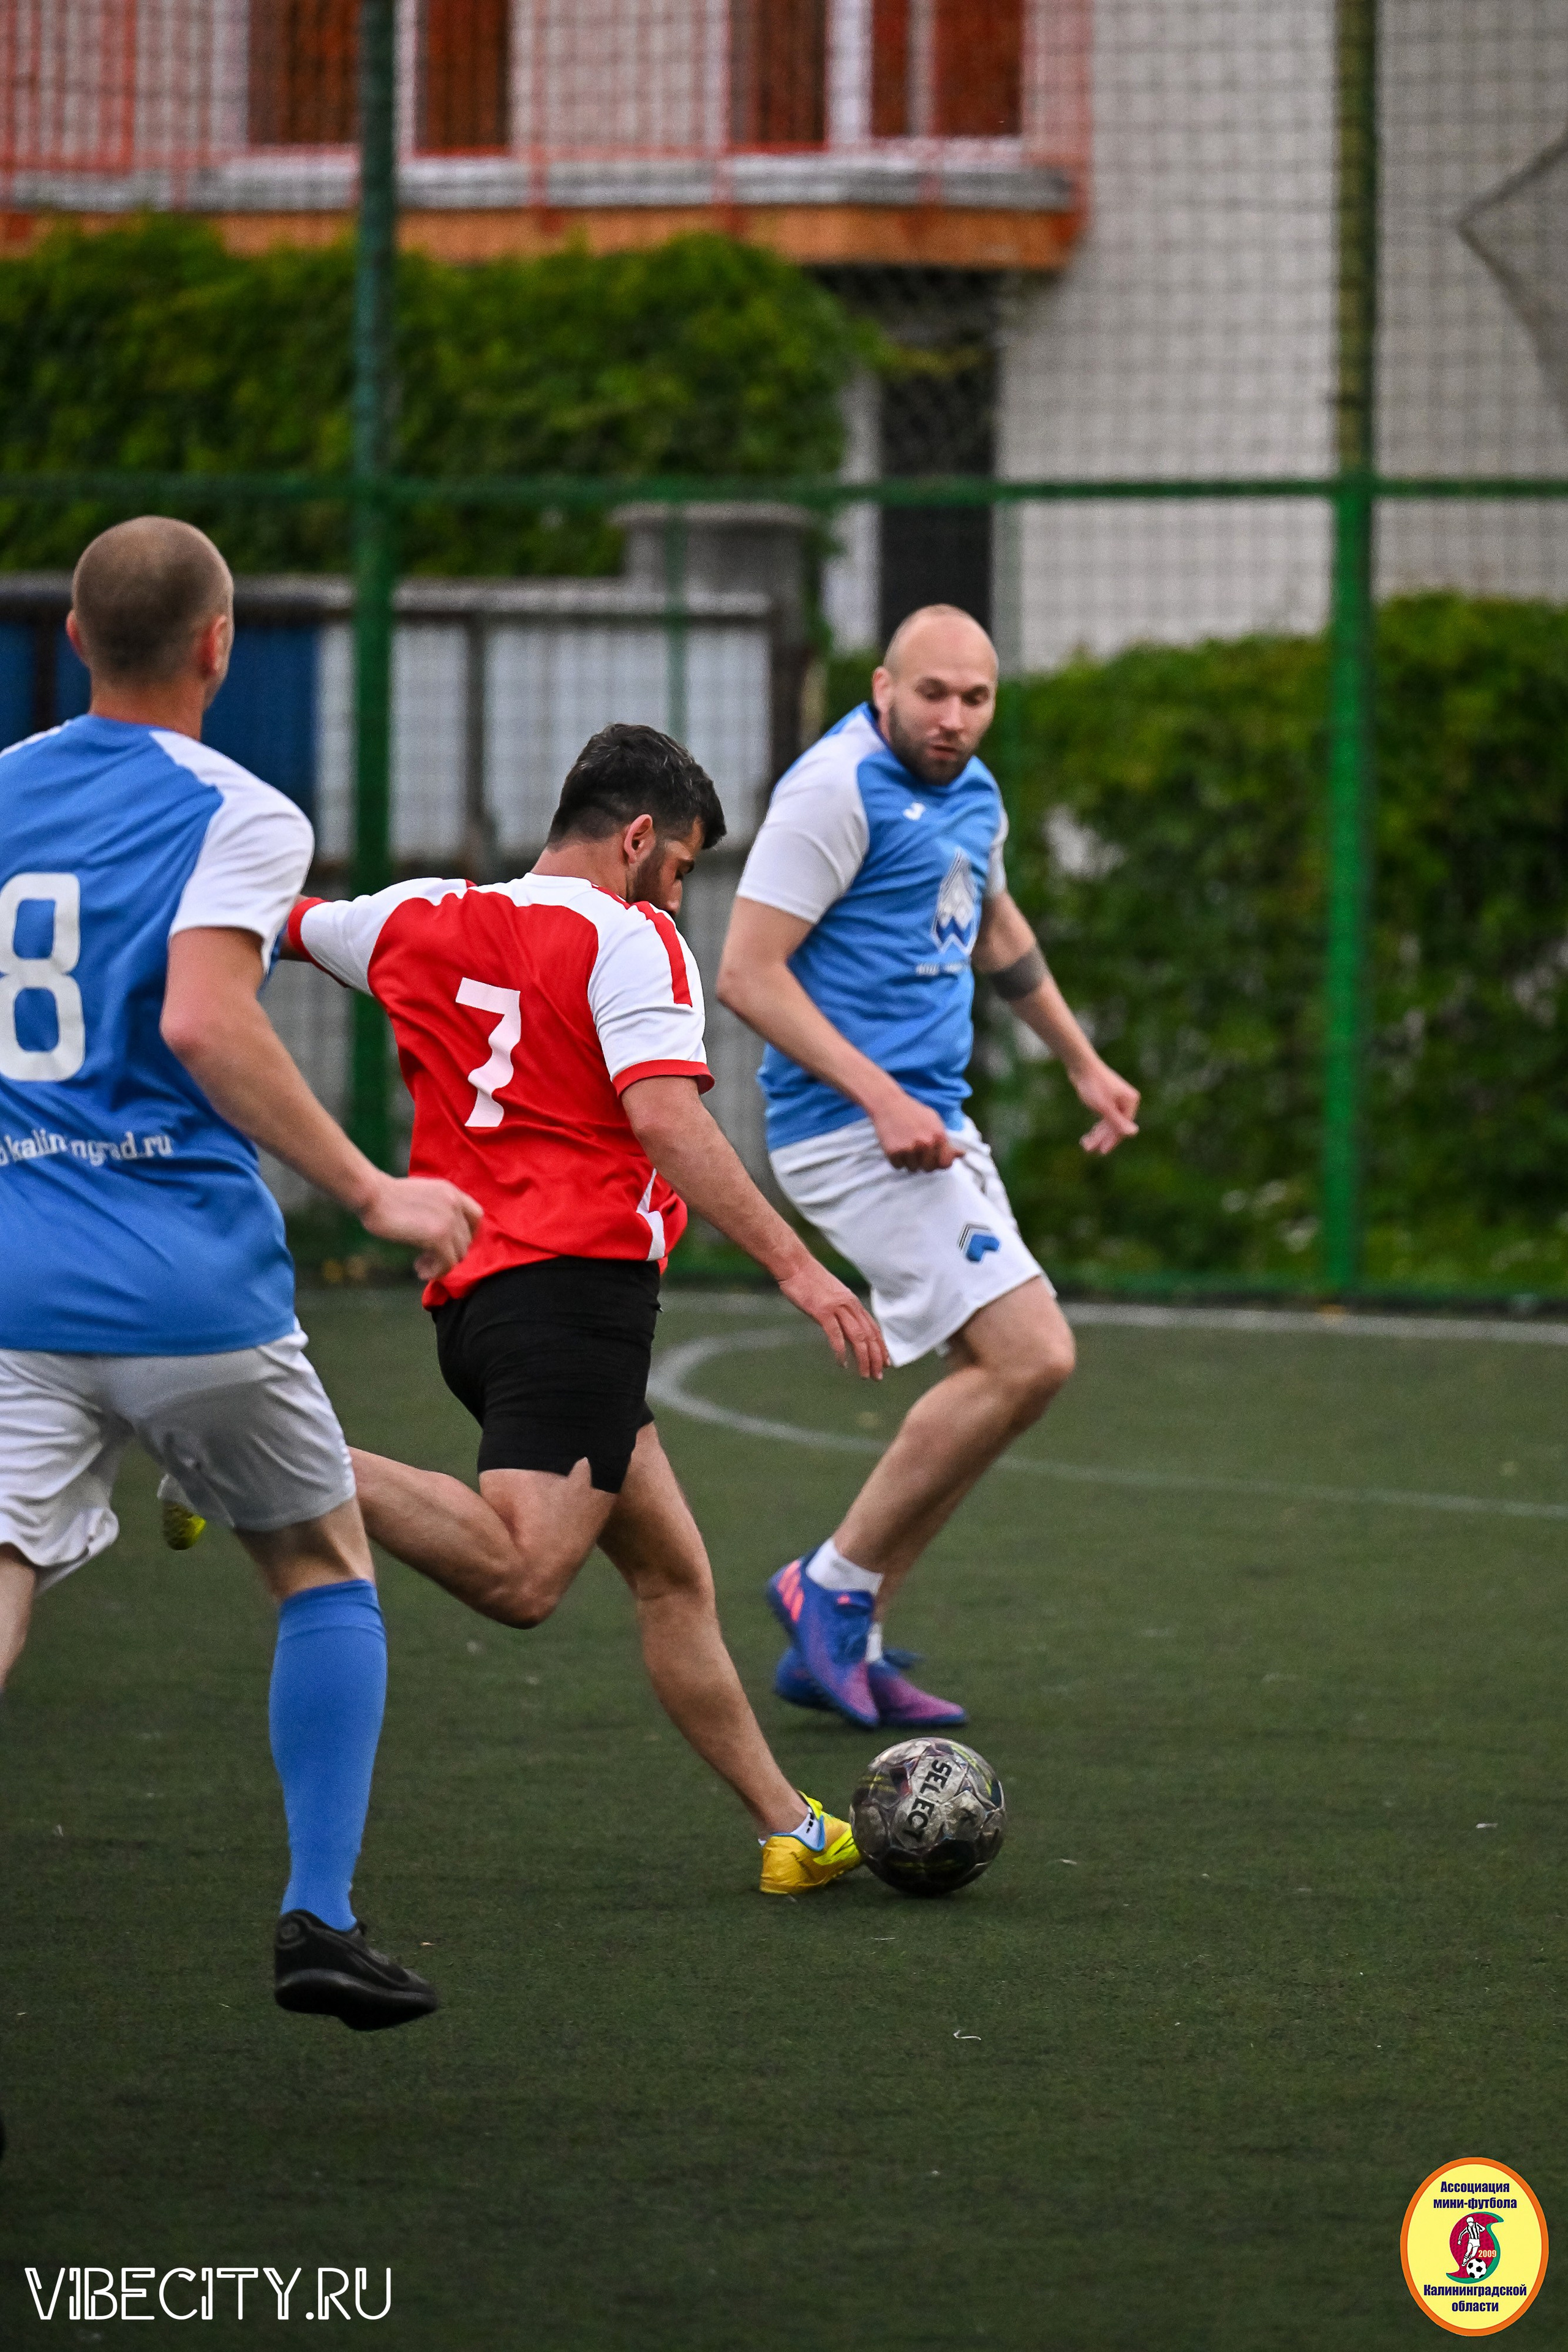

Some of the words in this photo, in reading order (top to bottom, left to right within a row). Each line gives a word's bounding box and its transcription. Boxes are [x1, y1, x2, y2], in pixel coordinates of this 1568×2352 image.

[0, 873, 85, 1082] 8
[455, 977, 521, 1128] 7
[902, 1760, 952, 1842] SELECT
